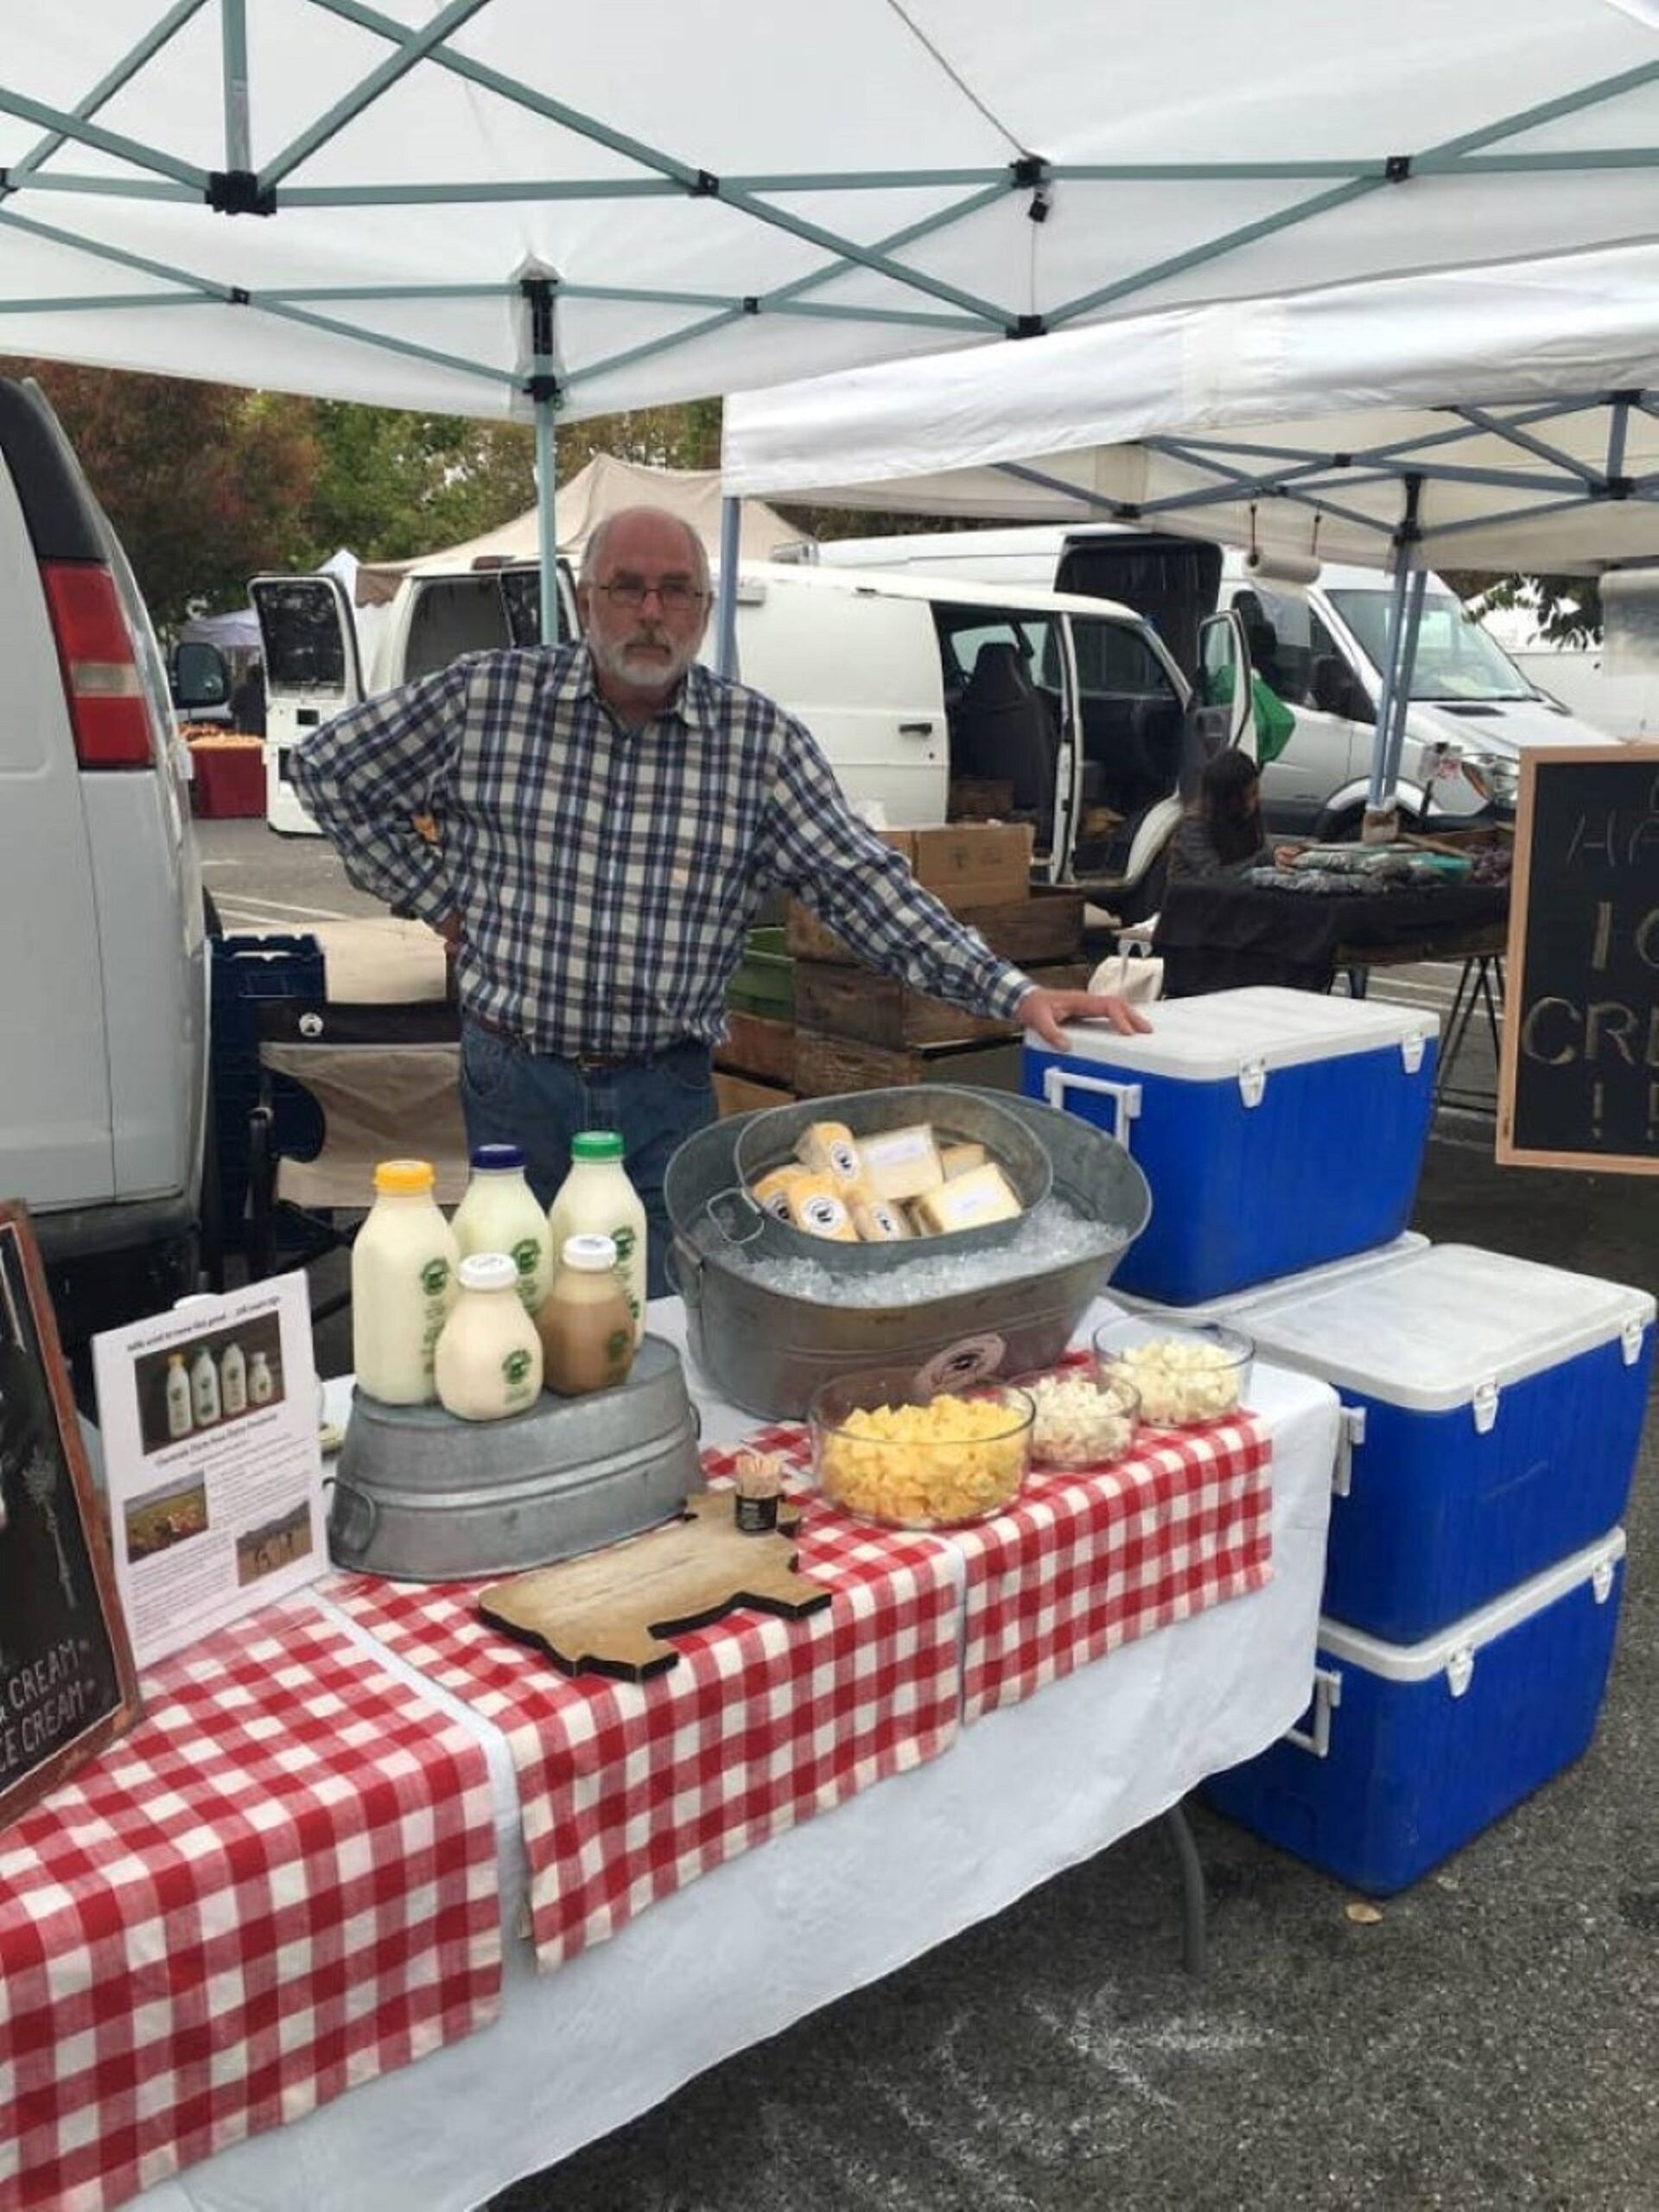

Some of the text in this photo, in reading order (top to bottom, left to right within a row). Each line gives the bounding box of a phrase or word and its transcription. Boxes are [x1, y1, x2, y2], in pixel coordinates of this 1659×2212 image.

[9, 1638, 79, 1709] CREAM
[0, 1680, 85, 1772] E CREAM
